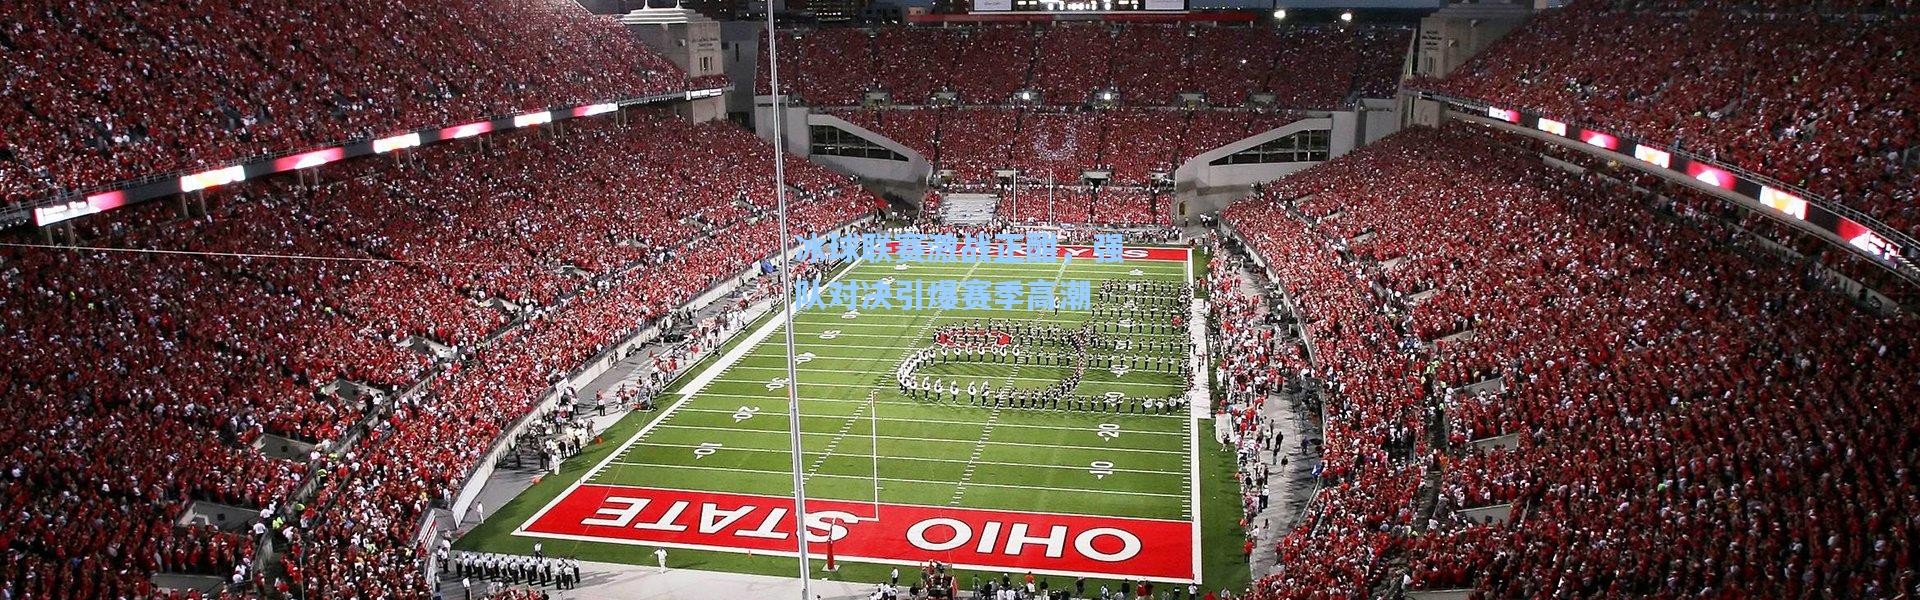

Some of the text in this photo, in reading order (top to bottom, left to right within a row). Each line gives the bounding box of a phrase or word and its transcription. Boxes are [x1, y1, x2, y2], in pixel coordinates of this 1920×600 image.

[732, 405, 760, 420] 20
[1097, 423, 1120, 438] 20
[693, 442, 723, 456] 10
[1088, 461, 1114, 475] 10
[581, 496, 1143, 562] OHIO STATE
